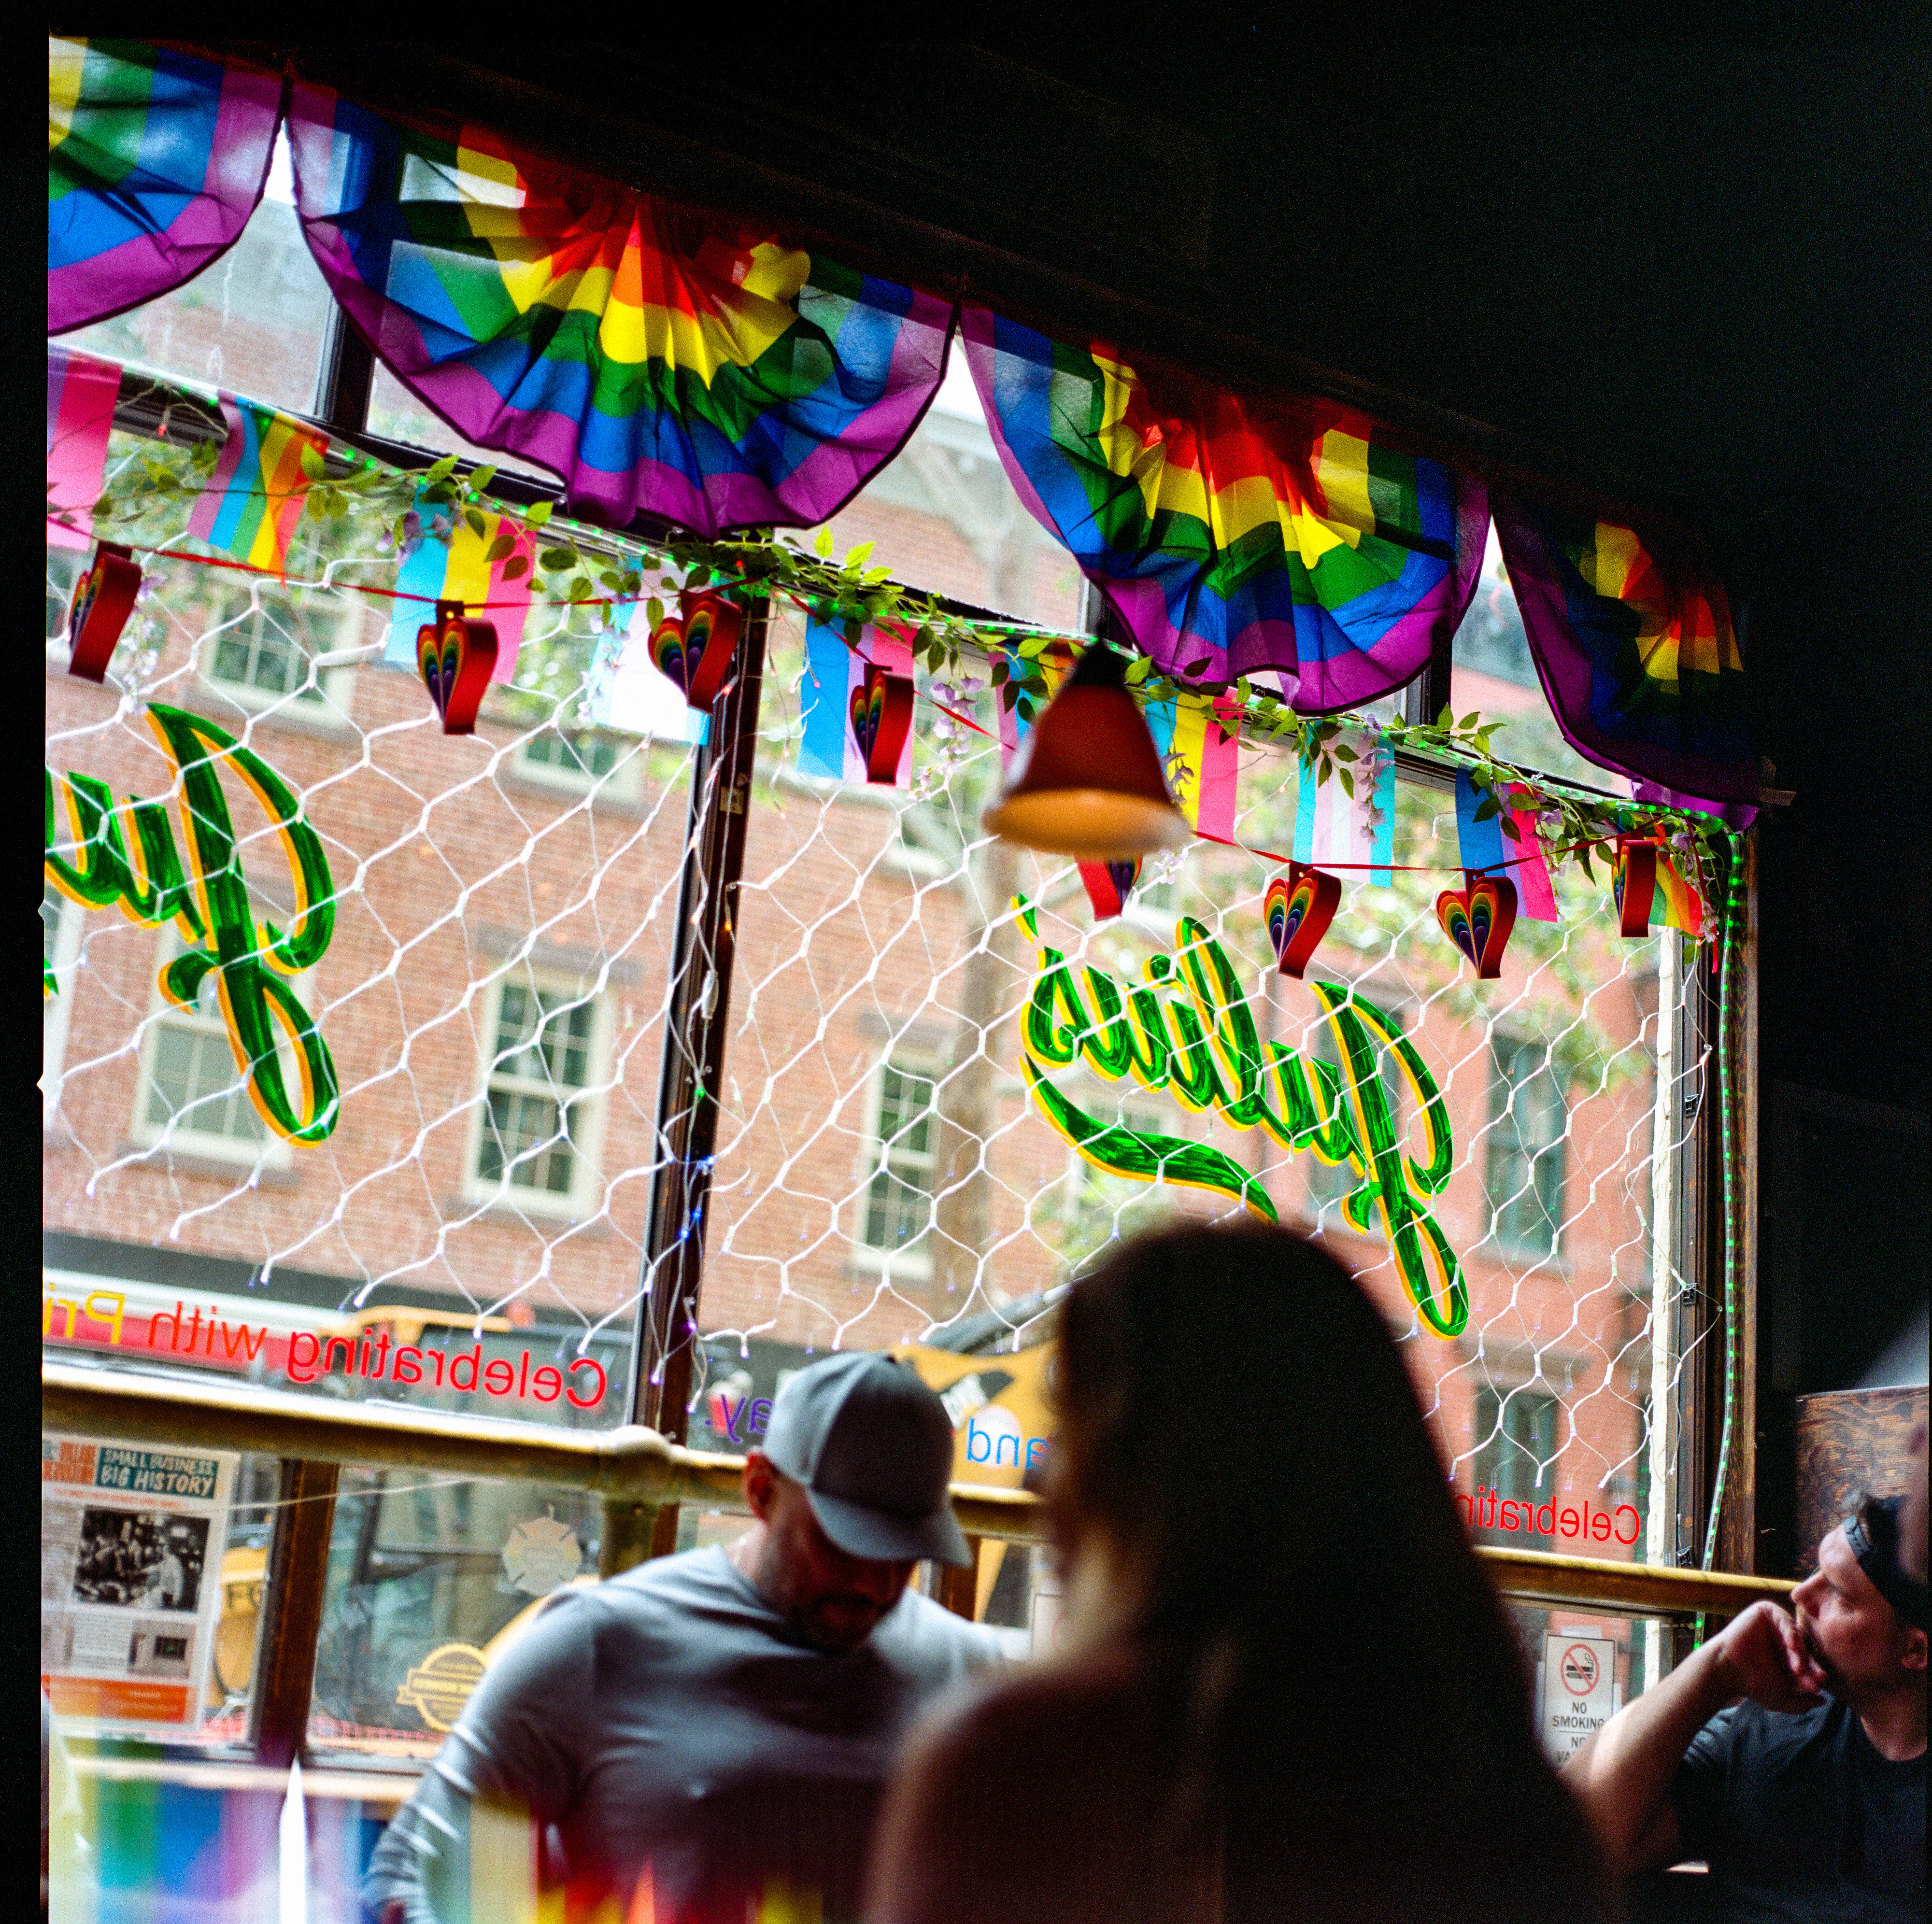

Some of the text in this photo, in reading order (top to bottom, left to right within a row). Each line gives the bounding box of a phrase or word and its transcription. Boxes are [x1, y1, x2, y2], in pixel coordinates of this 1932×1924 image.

[104, 1448, 146, 1468] SMALL
[100, 1465, 130, 1487] BIG
[133, 1469, 213, 1496] HISTORY
[1572, 1701, 1588, 1714] NO
